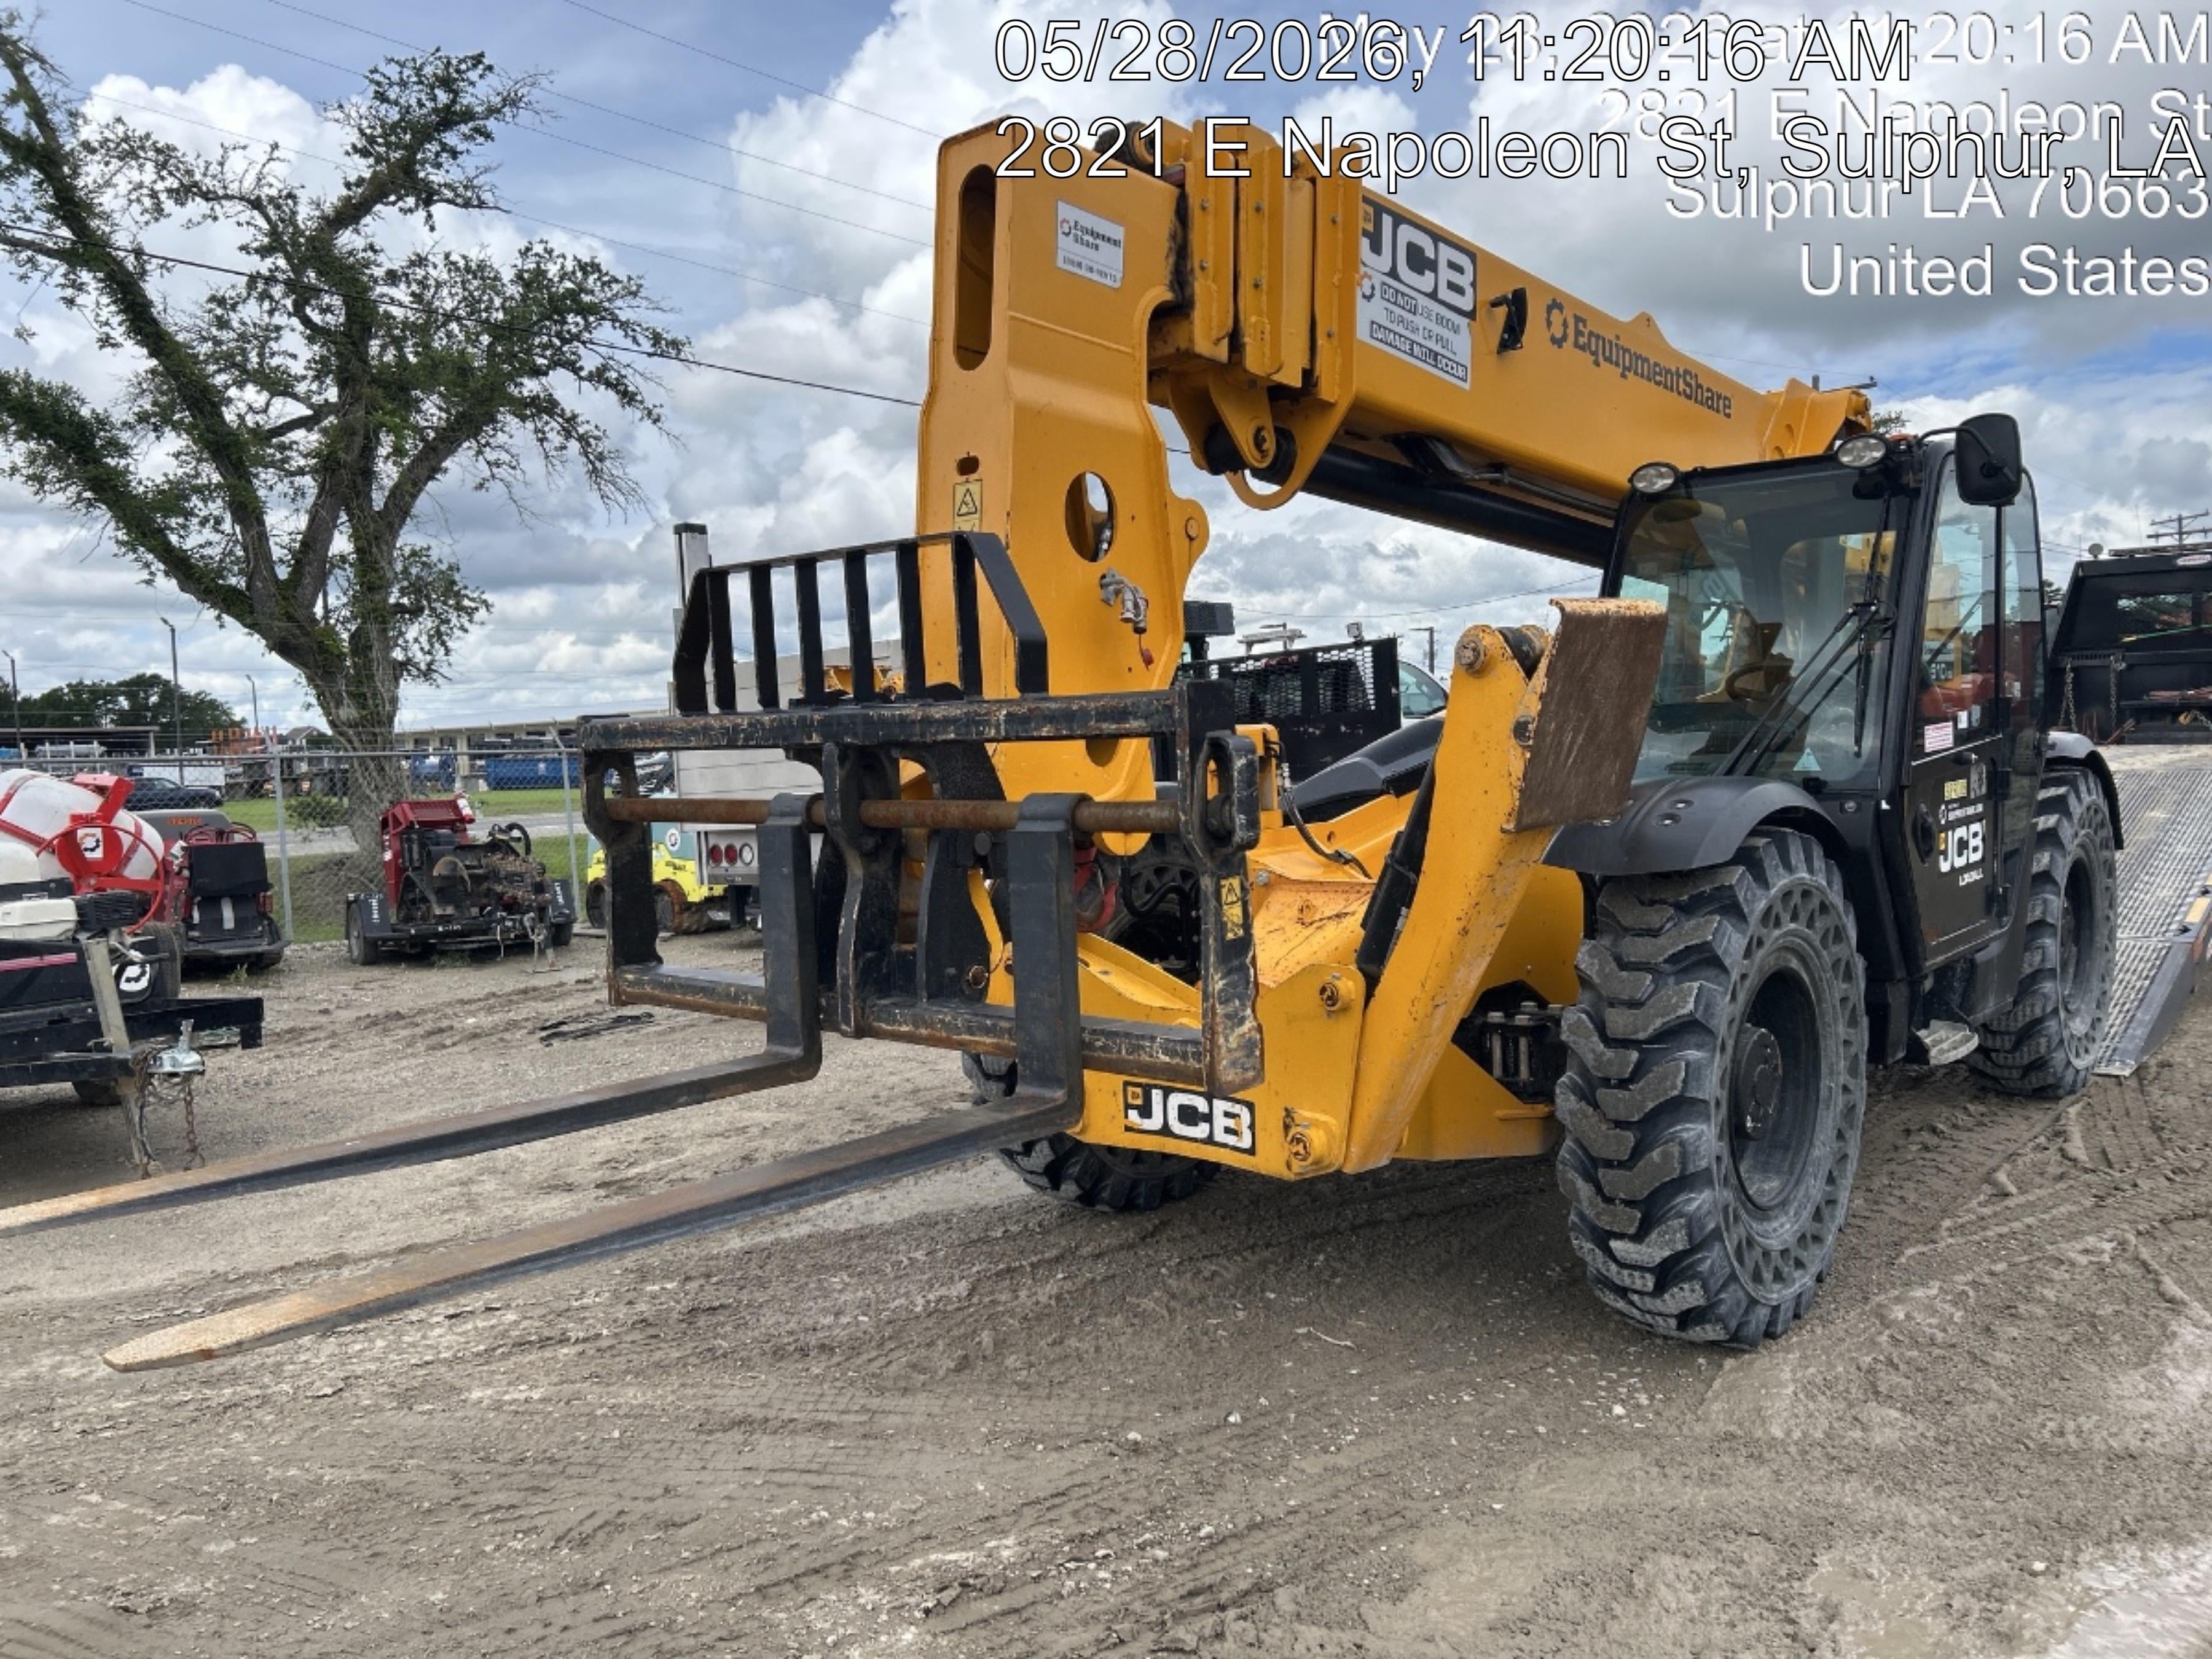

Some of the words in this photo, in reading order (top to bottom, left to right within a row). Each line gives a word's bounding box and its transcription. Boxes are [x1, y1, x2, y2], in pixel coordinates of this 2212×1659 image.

[1362, 212, 1473, 311] JCB
[1373, 323, 1411, 354] DAMAGE
[1574, 313, 1732, 418] EquipmentShare
[1939, 822, 1983, 873] JCB
[1128, 1088, 1252, 1149] JCB
